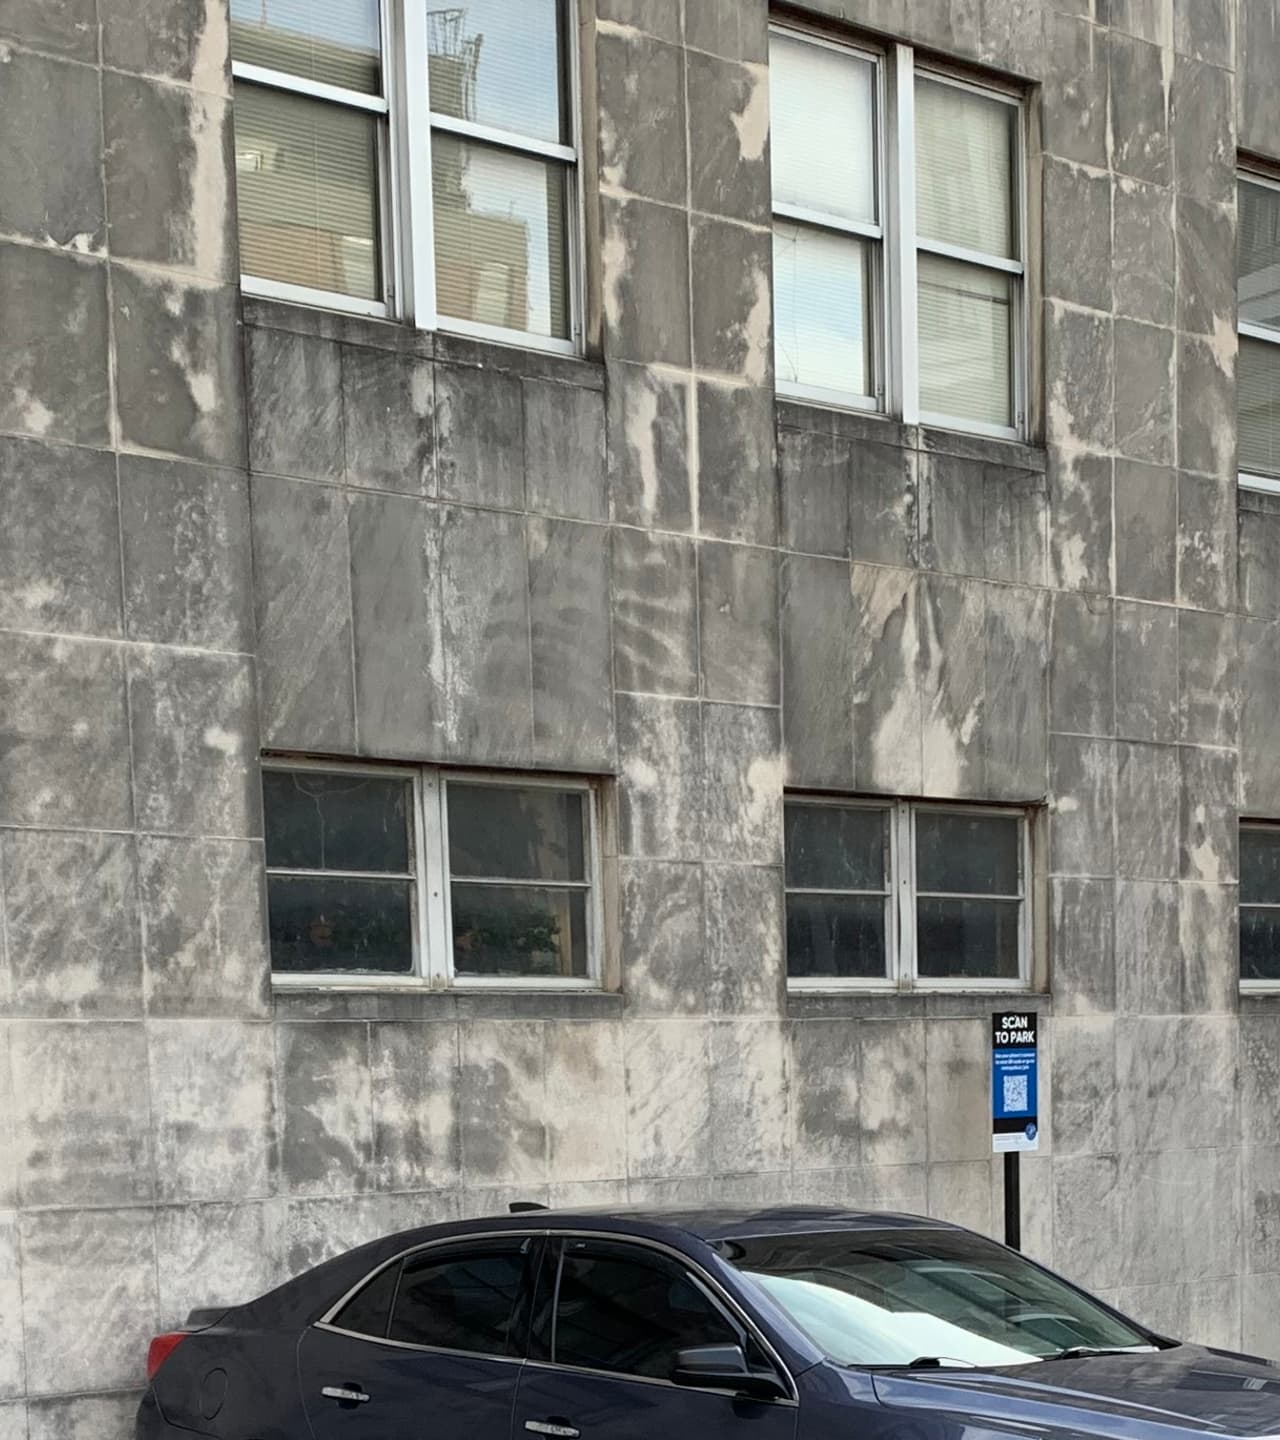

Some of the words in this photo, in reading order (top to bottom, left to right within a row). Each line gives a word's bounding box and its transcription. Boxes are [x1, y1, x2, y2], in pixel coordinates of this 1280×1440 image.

[1001, 1016, 1028, 1029] SCAN
[995, 1031, 1009, 1044] TO
[1010, 1031, 1035, 1044] PARK
